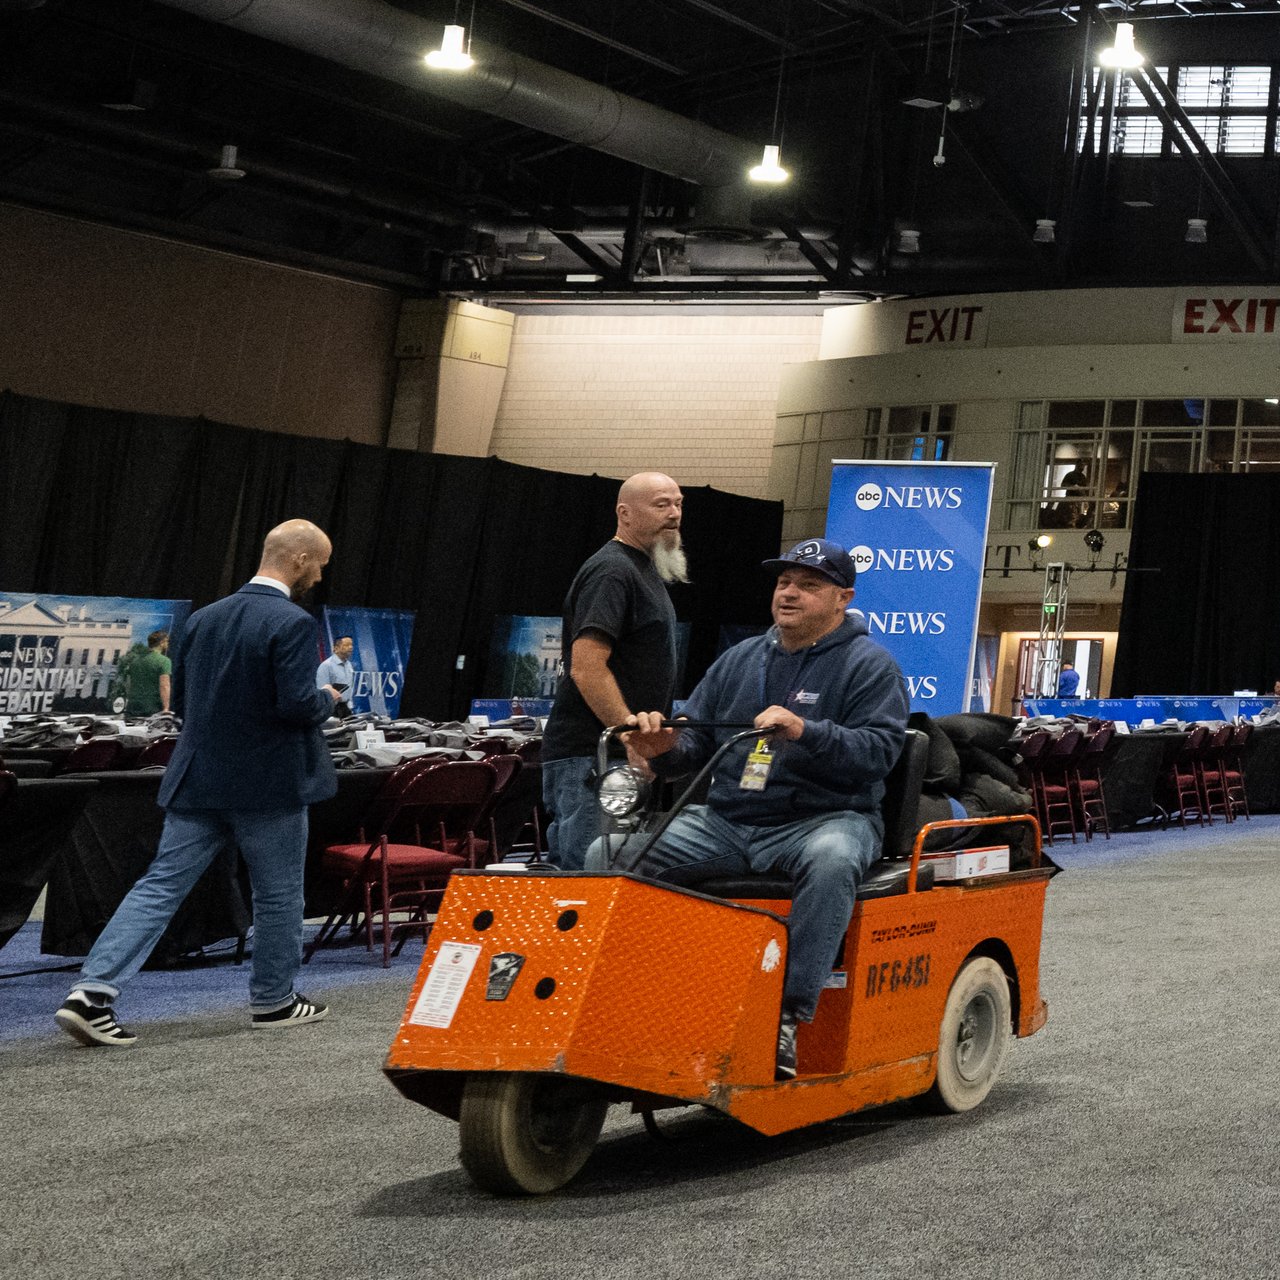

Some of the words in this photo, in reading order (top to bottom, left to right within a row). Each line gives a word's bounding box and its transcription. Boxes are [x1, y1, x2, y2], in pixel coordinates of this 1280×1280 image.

[905, 306, 983, 344] EXIT
[881, 487, 962, 509] NEWS
[874, 549, 954, 571] NEWS
[868, 612, 946, 635] NEWS
[14, 647, 54, 663] NEWS
[0, 668, 84, 689] IDENTIAL
[907, 676, 938, 699] WS
